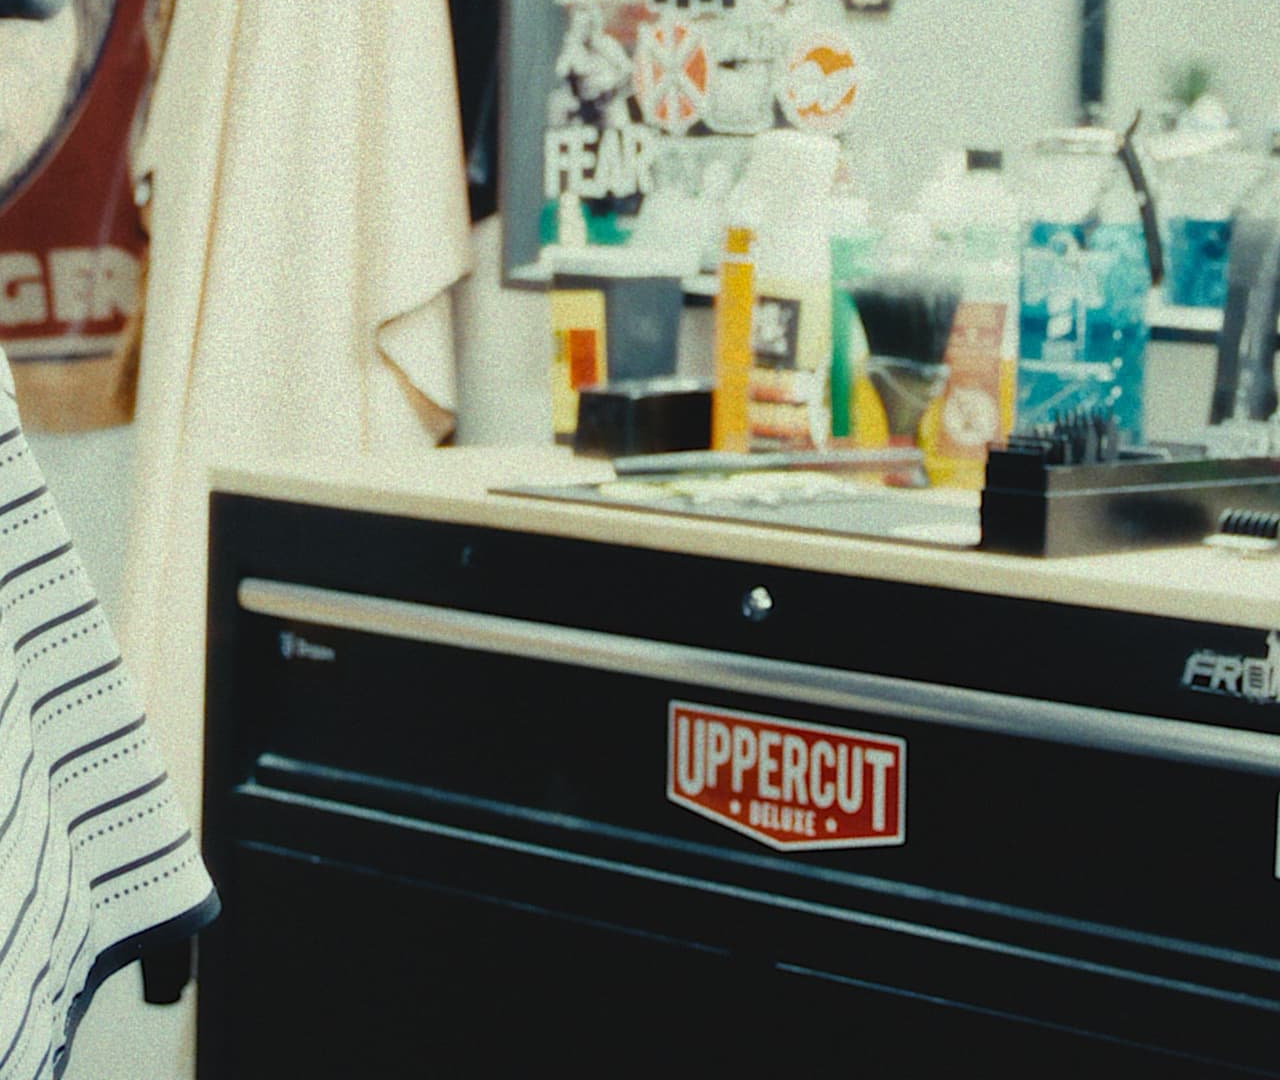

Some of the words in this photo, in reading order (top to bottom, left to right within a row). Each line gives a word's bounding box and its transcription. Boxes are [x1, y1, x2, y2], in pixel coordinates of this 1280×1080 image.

[544, 125, 654, 199] FEAR
[677, 716, 896, 832] UPPERCUT
[747, 802, 818, 838] DELUXE
